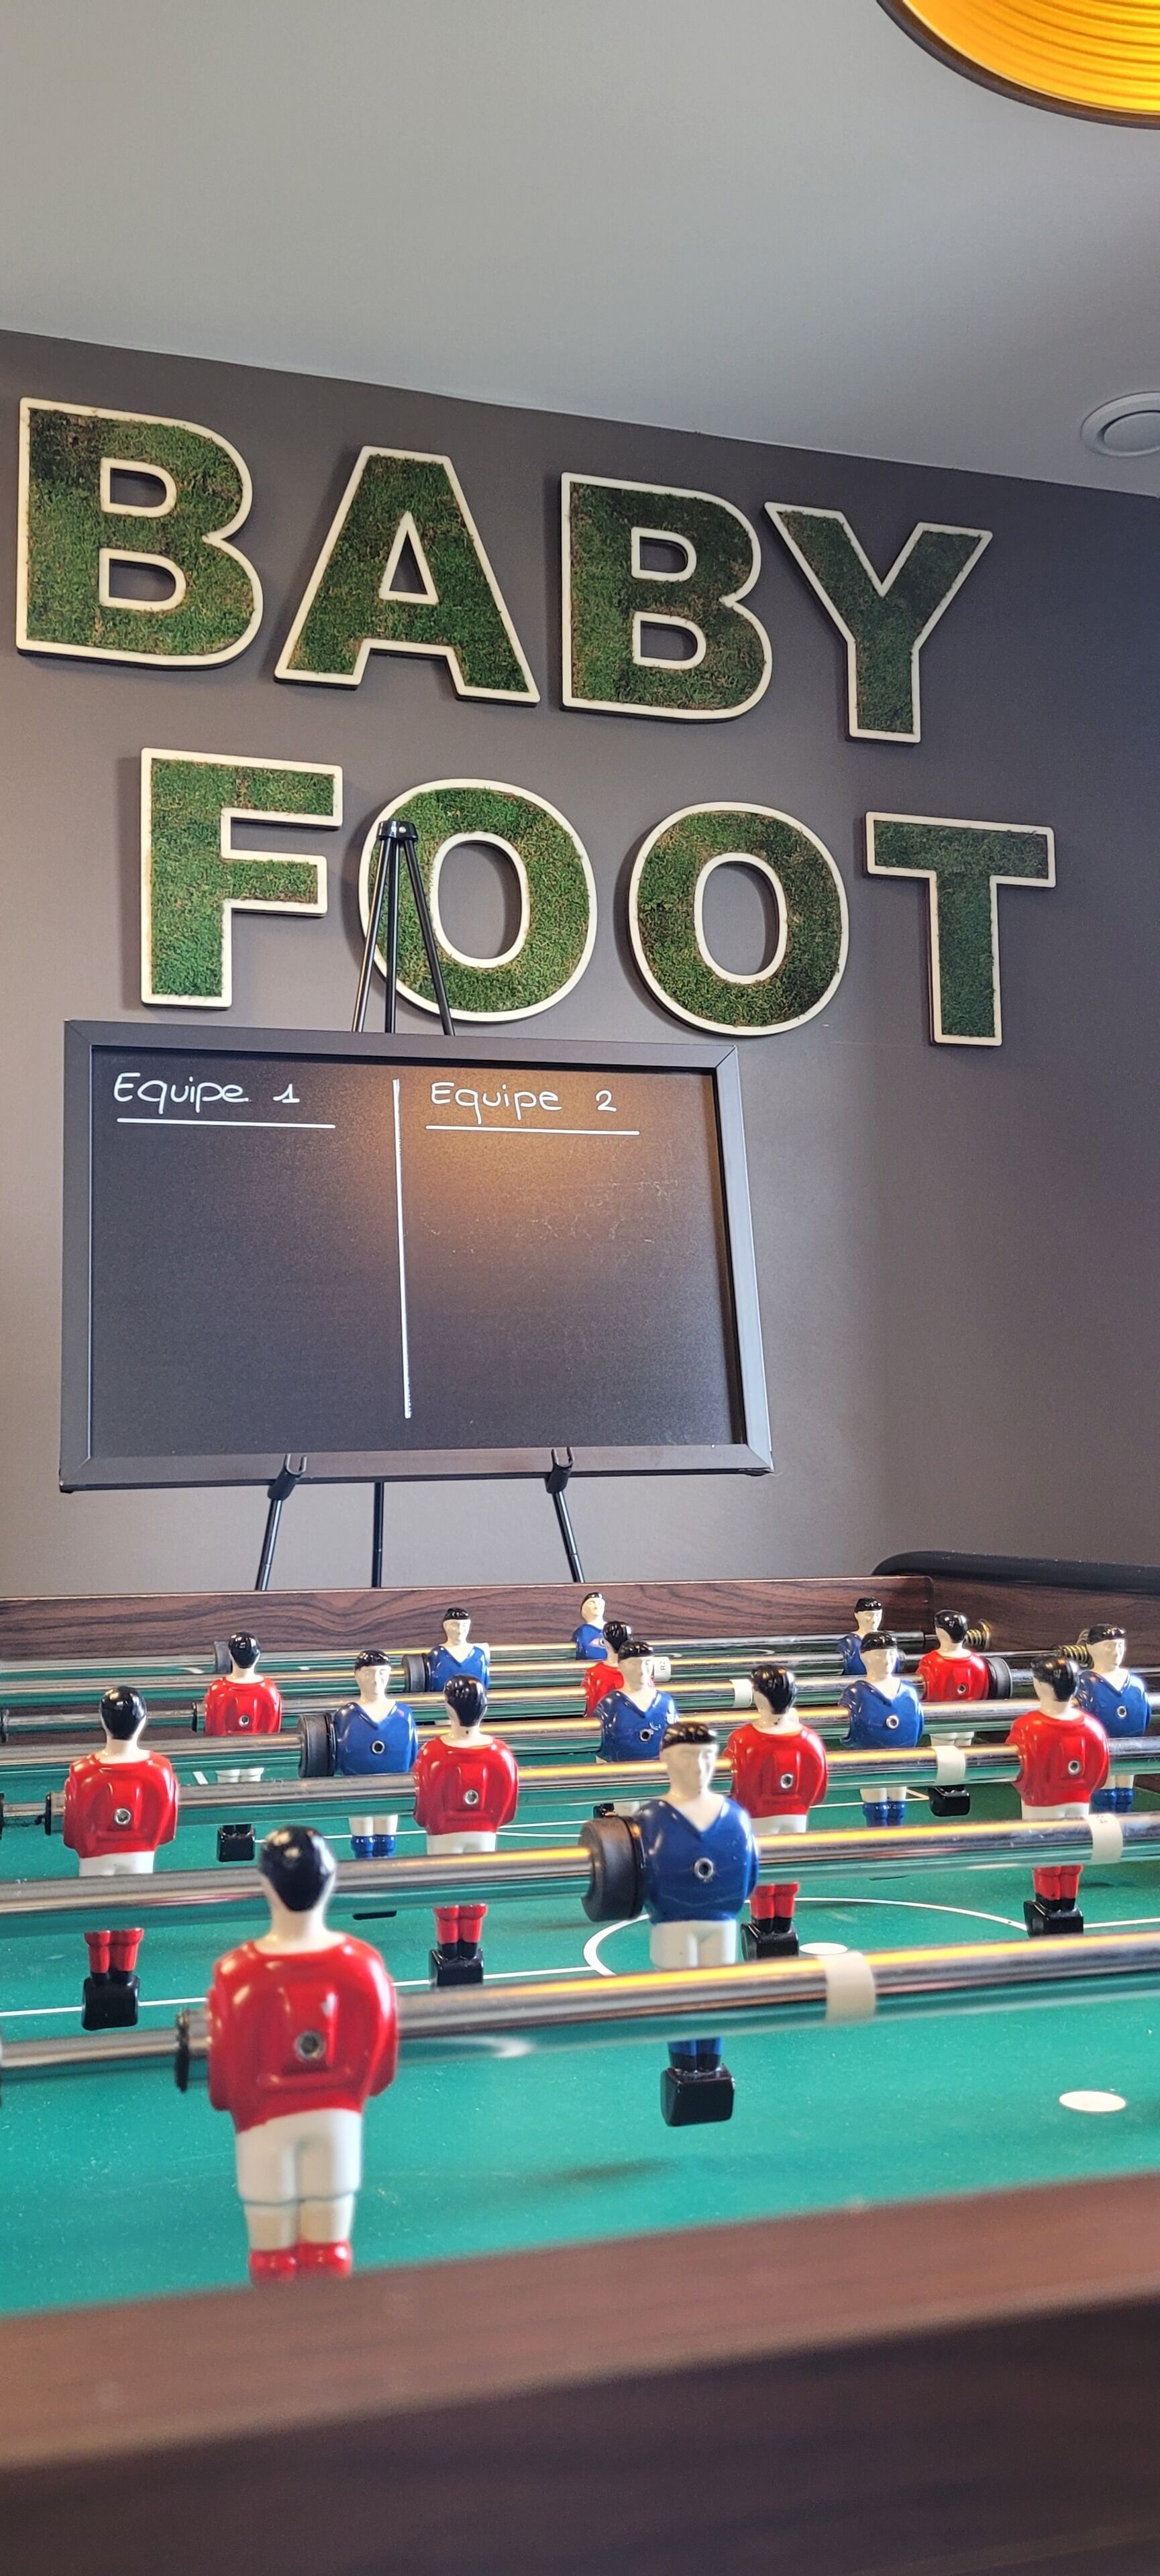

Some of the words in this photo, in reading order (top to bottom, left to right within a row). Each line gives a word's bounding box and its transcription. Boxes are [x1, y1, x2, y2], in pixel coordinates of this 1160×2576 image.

[16, 397, 993, 742] BABY
[140, 747, 1057, 1046] FOOT
[113, 1071, 249, 1114] Equipe
[273, 1079, 301, 1104] 1
[430, 1081, 563, 1123] Equipe
[596, 1089, 618, 1112] 2
